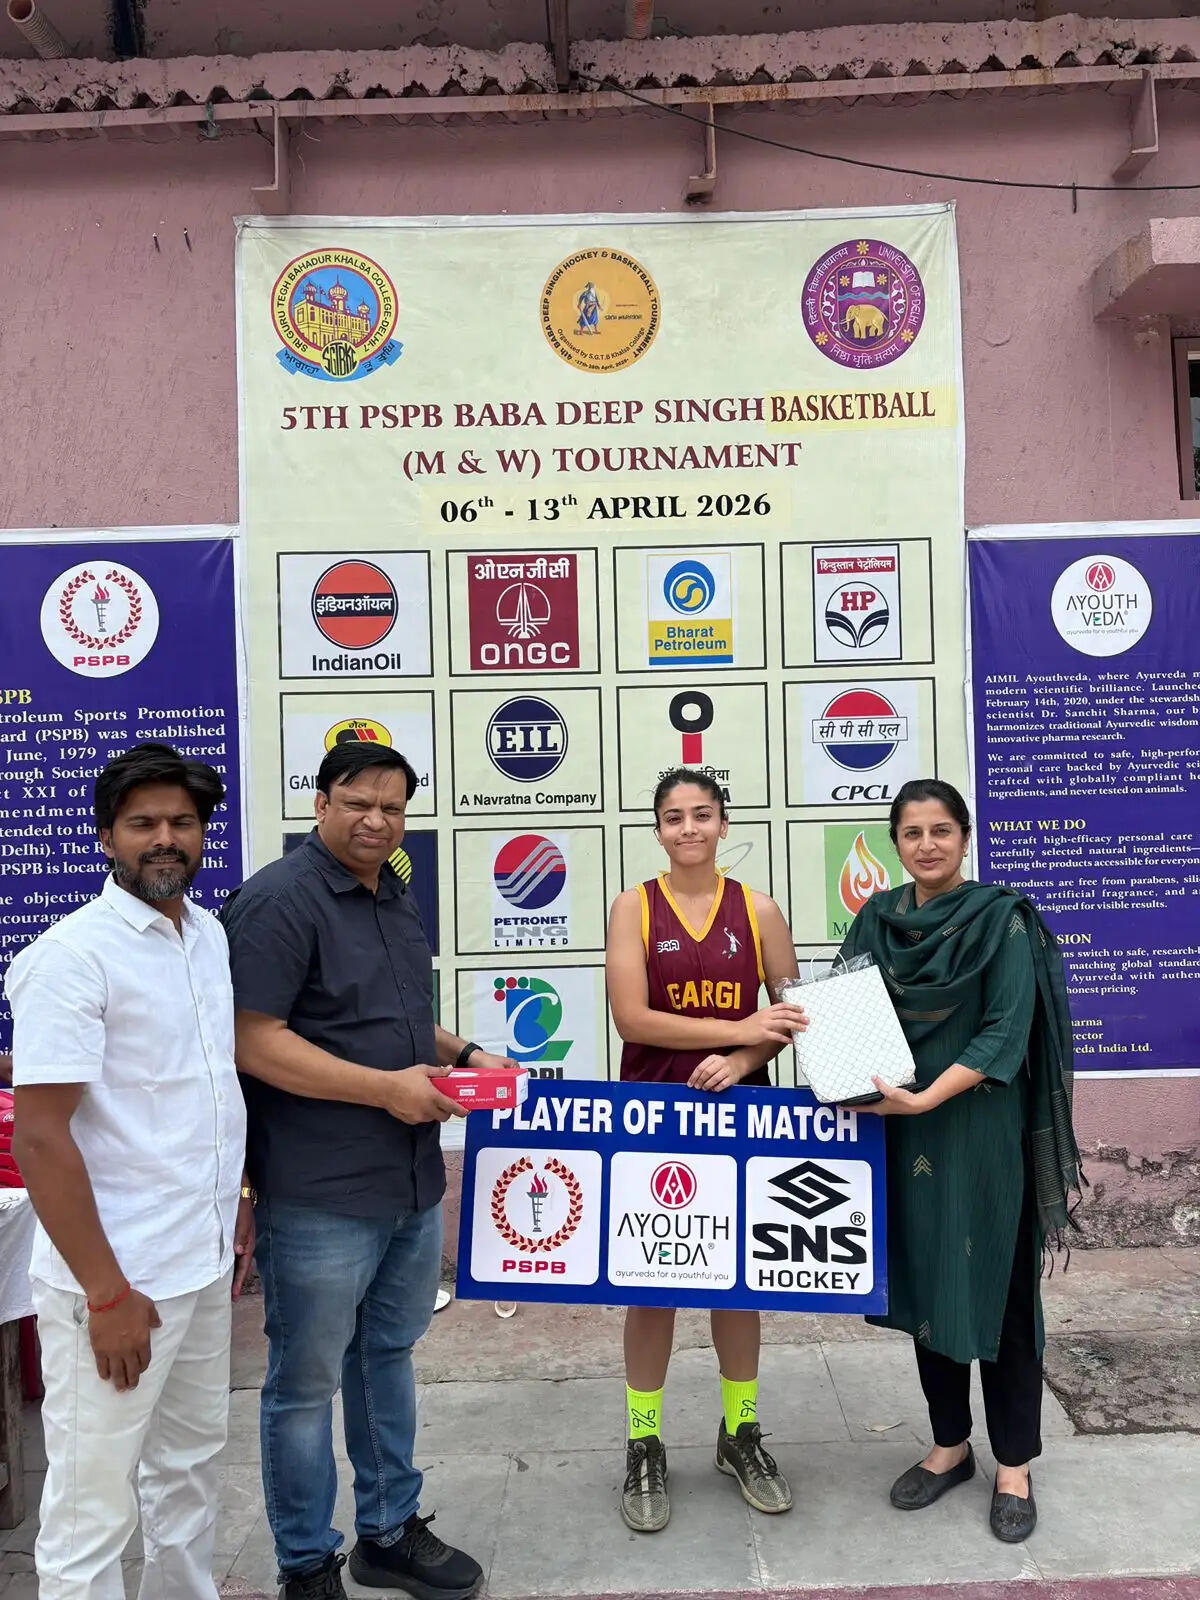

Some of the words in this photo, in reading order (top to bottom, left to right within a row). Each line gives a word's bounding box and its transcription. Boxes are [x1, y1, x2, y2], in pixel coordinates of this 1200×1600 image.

[288, 254, 332, 281] BAHADUR
[334, 254, 371, 274] KHALSA
[563, 251, 599, 270] HOCKEY
[879, 245, 916, 282] UNIVERSITY
[611, 252, 655, 296] BASKETBALL
[546, 269, 564, 296] SINGH
[277, 281, 291, 307] TEGH
[911, 286, 920, 297] OF
[908, 300, 920, 326] DELHI
[278, 310, 294, 338] GURU
[633, 298, 658, 357] TOURNAMENT
[546, 325, 560, 348] BABA
[558, 328, 580, 354] Organised
[580, 350, 588, 359] by
[611, 346, 630, 360] Khalsa
[629, 327, 645, 347] College
[294, 341, 308, 352] SRI
[560, 347, 572, 361] 4th
[280, 404, 349, 430] 5TH
[360, 404, 443, 429] PSPB
[454, 402, 547, 428] BABA
[555, 400, 643, 426] DEEP
[655, 397, 765, 424] SINGH
[770, 391, 936, 423] BASKETBALL
[403, 450, 446, 481] (M
[457, 449, 487, 475] &
[496, 449, 541, 479] W)
[552, 442, 802, 472] TOURNAMENT
[441, 495, 494, 523] 06th
[527, 494, 578, 521] 13th
[586, 496, 686, 520] APRIL
[697, 493, 771, 517] 2026
[820, 559, 853, 573] हिन्दुस्तान
[857, 557, 892, 571] पेट्रोलियम
[840, 592, 876, 611] HP
[1066, 593, 1137, 611] AYOUTH
[667, 626, 714, 639] Bharat
[654, 638, 727, 651] Petroleum
[73, 655, 130, 667] PSPB
[480, 642, 570, 665] ONGC
[312, 653, 401, 671] IndianOil
[985, 674, 1019, 683] AIMIL
[1025, 673, 1091, 685] Ayouthveda,
[1098, 672, 1130, 681] where
[1135, 671, 1186, 681] Ayurveda
[986, 687, 1027, 695] modern
[1033, 685, 1084, 694] scientific
[1089, 683, 1145, 693] brilliance.
[74, 709, 127, 725] Sports
[137, 706, 225, 720] Promotion
[35, 728, 89, 745] (PSPB)
[97, 731, 128, 740] was
[135, 724, 226, 739] established
[496, 725, 558, 753] EIL
[987, 735, 1041, 743] innovative
[1042, 734, 1080, 744] pharma
[1081, 732, 1126, 741] research.
[6, 749, 47, 764] June,
[60, 747, 97, 760] 1979
[1031, 751, 1087, 761] committed
[1110, 750, 1135, 760] safe,
[22, 786, 56, 799] XXI
[68, 785, 87, 797] of
[460, 794, 470, 806] A
[473, 793, 532, 806] Navratna
[535, 792, 597, 808] Company
[831, 784, 892, 800] CPCL
[988, 789, 1048, 800] ingredients,
[1049, 788, 1068, 796] and
[1069, 788, 1097, 796] never
[1099, 786, 1129, 795] tested
[1145, 785, 1187, 794] animals.
[56, 825, 73, 835] to
[989, 820, 1033, 832] WHAT
[1037, 820, 1060, 830] WE
[1064, 819, 1086, 830] DO
[989, 837, 1006, 845] We
[1011, 836, 1037, 845] craft
[1044, 834, 1112, 846] high-efficacy
[1118, 832, 1164, 843] personal
[60, 842, 90, 854] The
[1, 862, 43, 876] PSPB
[46, 862, 60, 874] is
[990, 860, 1030, 871] keeping
[1031, 860, 1048, 869] the
[1048, 858, 1092, 870] products
[1094, 857, 1143, 867] accessible
[1144, 857, 1159, 865] for
[1010, 879, 1054, 888] products
[1079, 877, 1098, 886] free
[1102, 877, 1125, 885] from
[1130, 876, 1179, 887] parabens,
[214, 888, 229, 898] to
[1035, 902, 1079, 913] designed
[1080, 901, 1095, 910] for
[1097, 901, 1129, 909] visible
[1131, 900, 1167, 909] results.
[494, 916, 567, 926] PETRONET
[494, 926, 568, 938] LNG
[494, 938, 568, 947] LIMITED
[1071, 973, 1123, 984] Ayurveda
[1130, 972, 1155, 980] with
[1067, 986, 1099, 994] honest
[1101, 985, 1139, 995] pricing.
[1099, 1043, 1127, 1053] India
[1131, 1043, 1152, 1052] Ltd.
[491, 1097, 613, 1134] PLAYER
[623, 1099, 665, 1135] OF
[674, 1101, 737, 1138] THE
[747, 1104, 858, 1142] MATCH
[617, 1212, 729, 1241] AYOUTH
[752, 1222, 868, 1265] SNS
[502, 1259, 566, 1275] PSPB
[616, 1269, 656, 1280] ayurveda
[657, 1270, 668, 1278] for
[679, 1270, 712, 1280] youthful
[714, 1273, 729, 1281] you
[758, 1268, 861, 1290] HOCKEY
